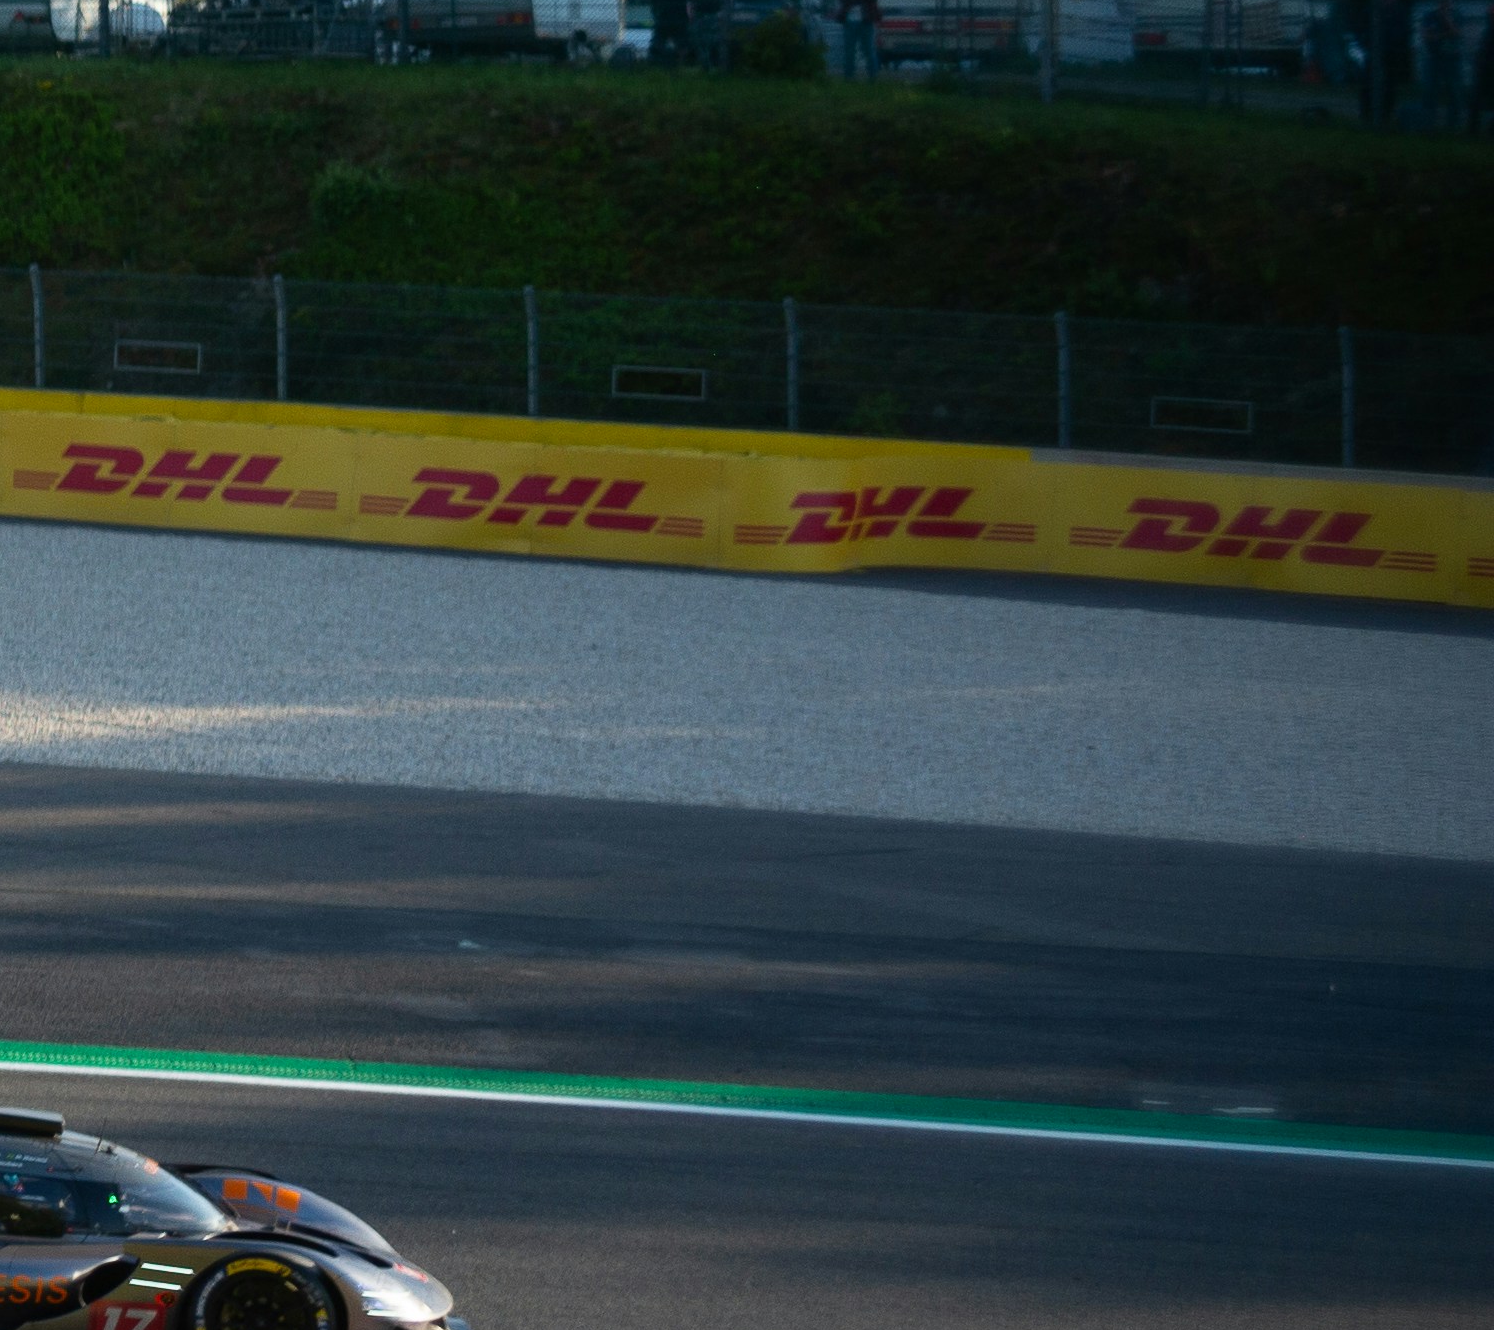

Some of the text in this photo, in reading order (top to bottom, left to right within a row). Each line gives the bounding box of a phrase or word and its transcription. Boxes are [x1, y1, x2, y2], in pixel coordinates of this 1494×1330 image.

[56, 443, 294, 507] DHL
[405, 466, 660, 533] DHL
[784, 486, 988, 545] DHL
[1118, 497, 1385, 567] DHL
